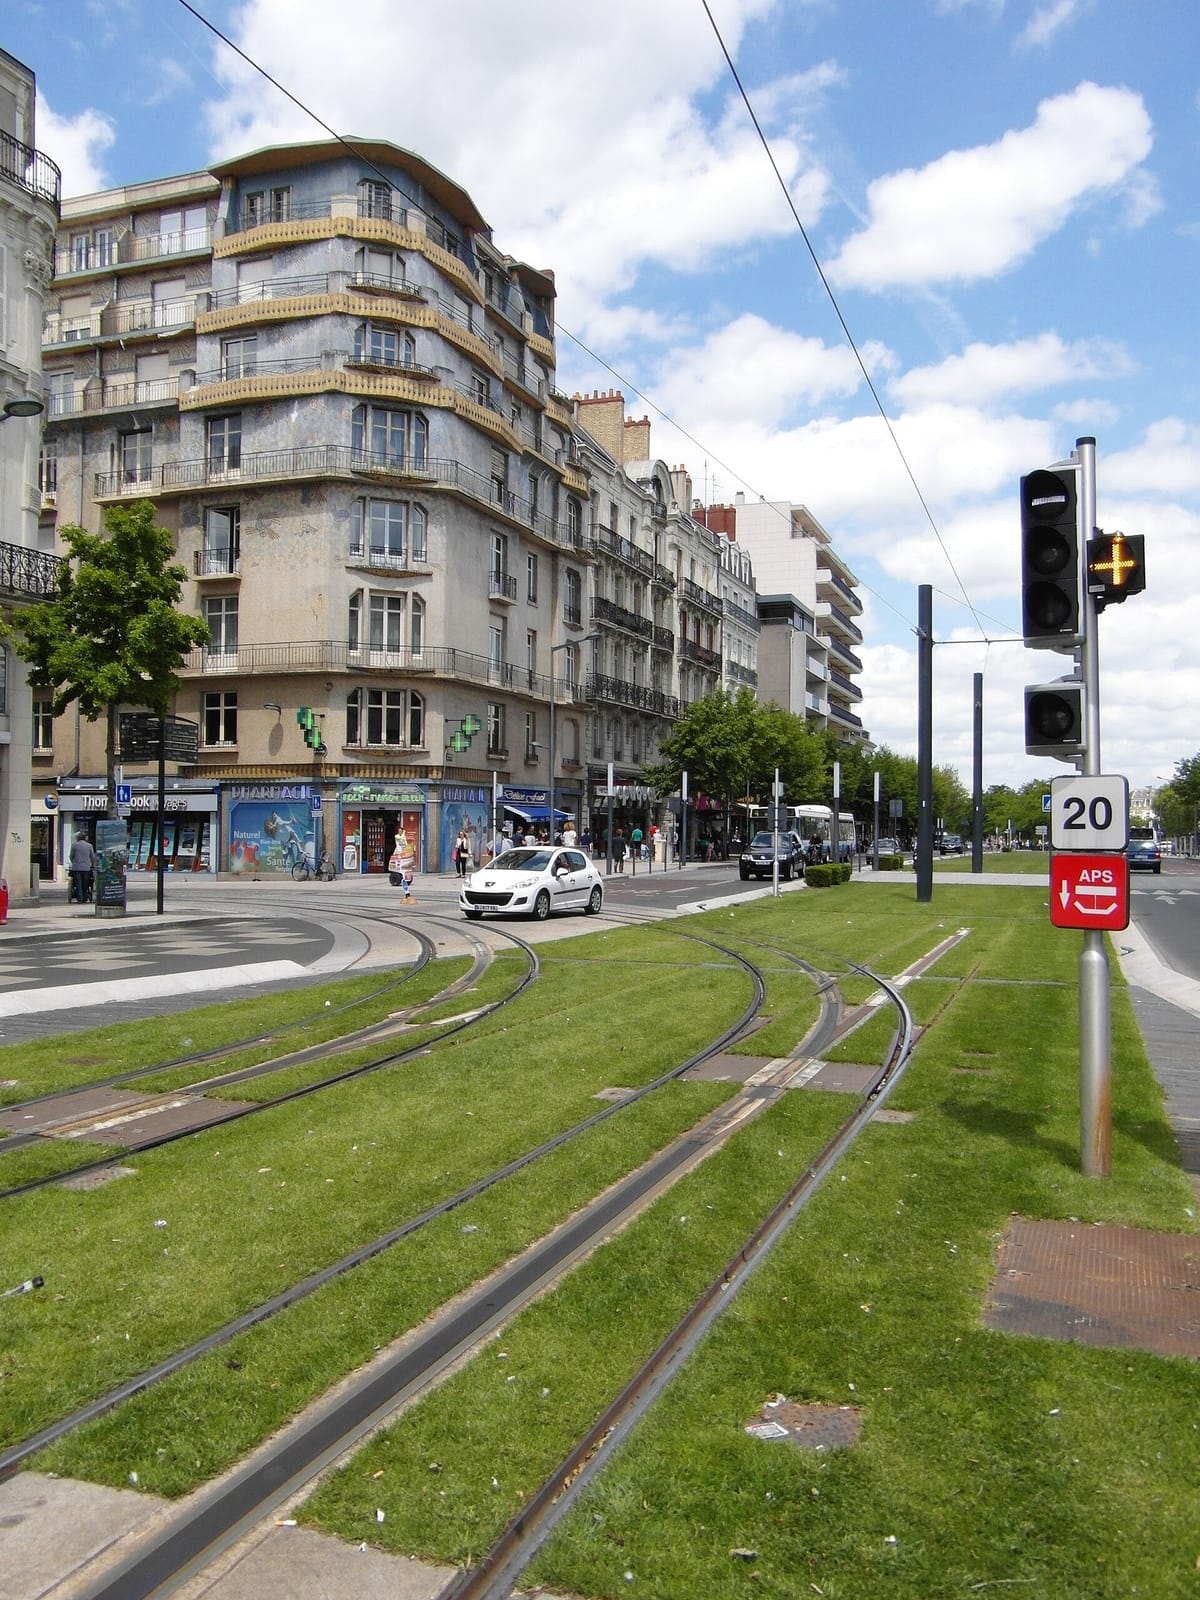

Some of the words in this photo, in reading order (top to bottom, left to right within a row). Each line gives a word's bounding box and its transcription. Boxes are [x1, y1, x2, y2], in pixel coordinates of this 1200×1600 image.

[231, 785, 315, 799] PHARMACIE
[127, 795, 150, 808] ook
[1063, 796, 1113, 830] 20
[233, 830, 261, 839] Naturel
[1079, 869, 1113, 883] APS
